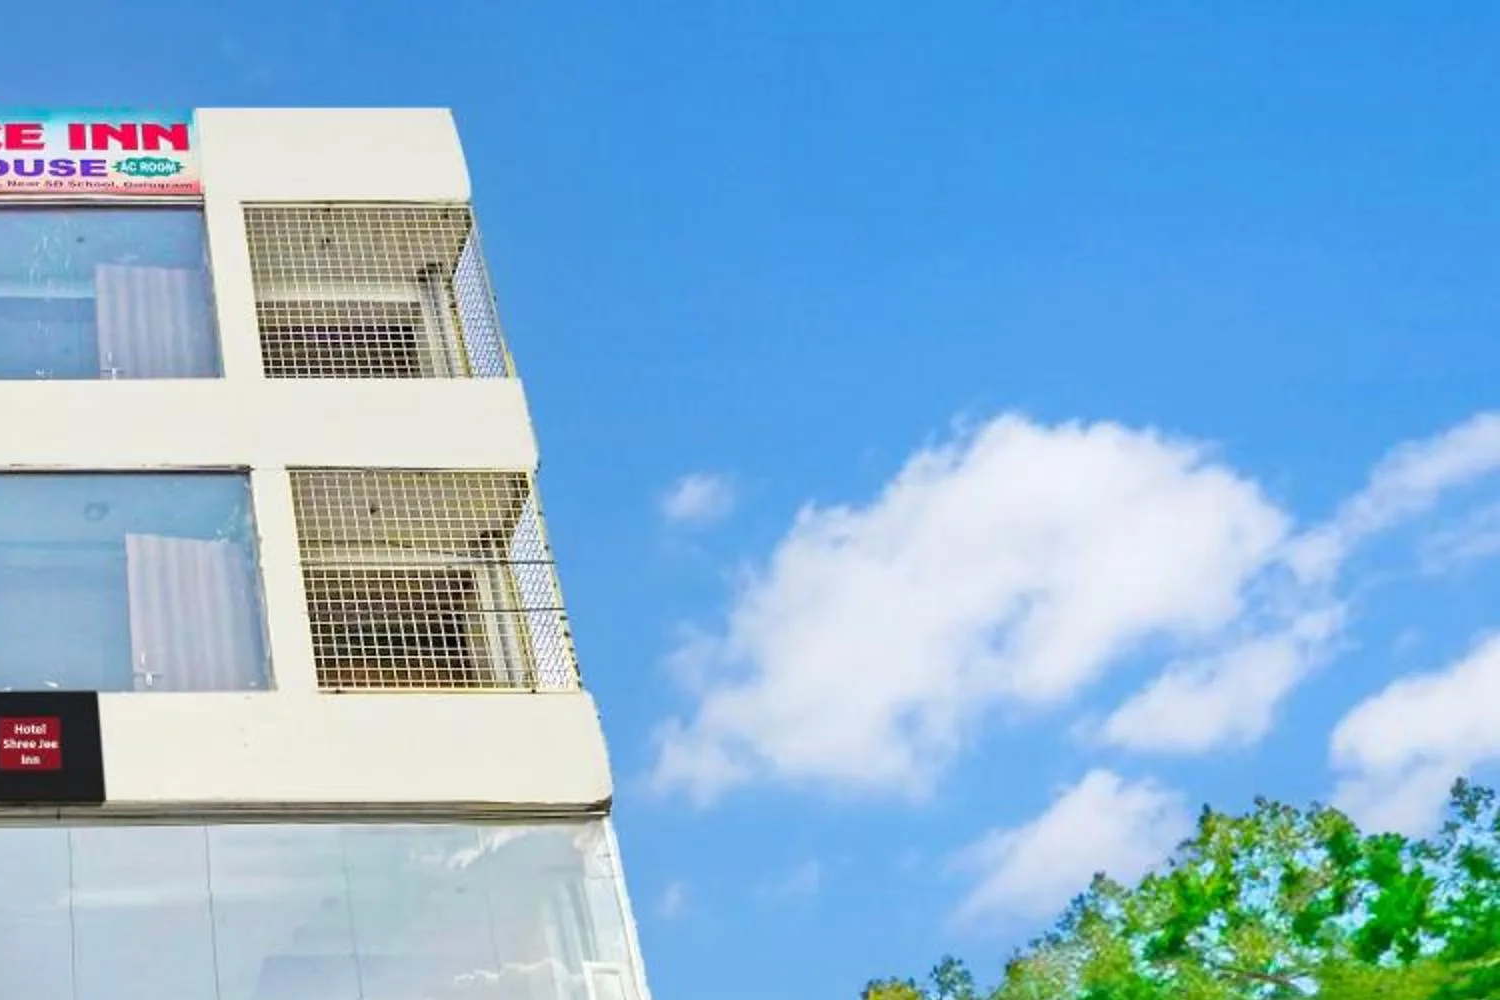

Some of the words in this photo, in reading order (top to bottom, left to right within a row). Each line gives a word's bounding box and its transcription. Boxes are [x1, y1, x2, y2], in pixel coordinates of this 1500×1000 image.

[67, 123, 191, 151] INN
[119, 161, 137, 173] AC
[140, 161, 177, 174] ROOM
[14, 723, 47, 735] Hotel
[3, 738, 37, 749] Shree
[38, 738, 59, 749] Jee
[21, 754, 41, 765] Inn
